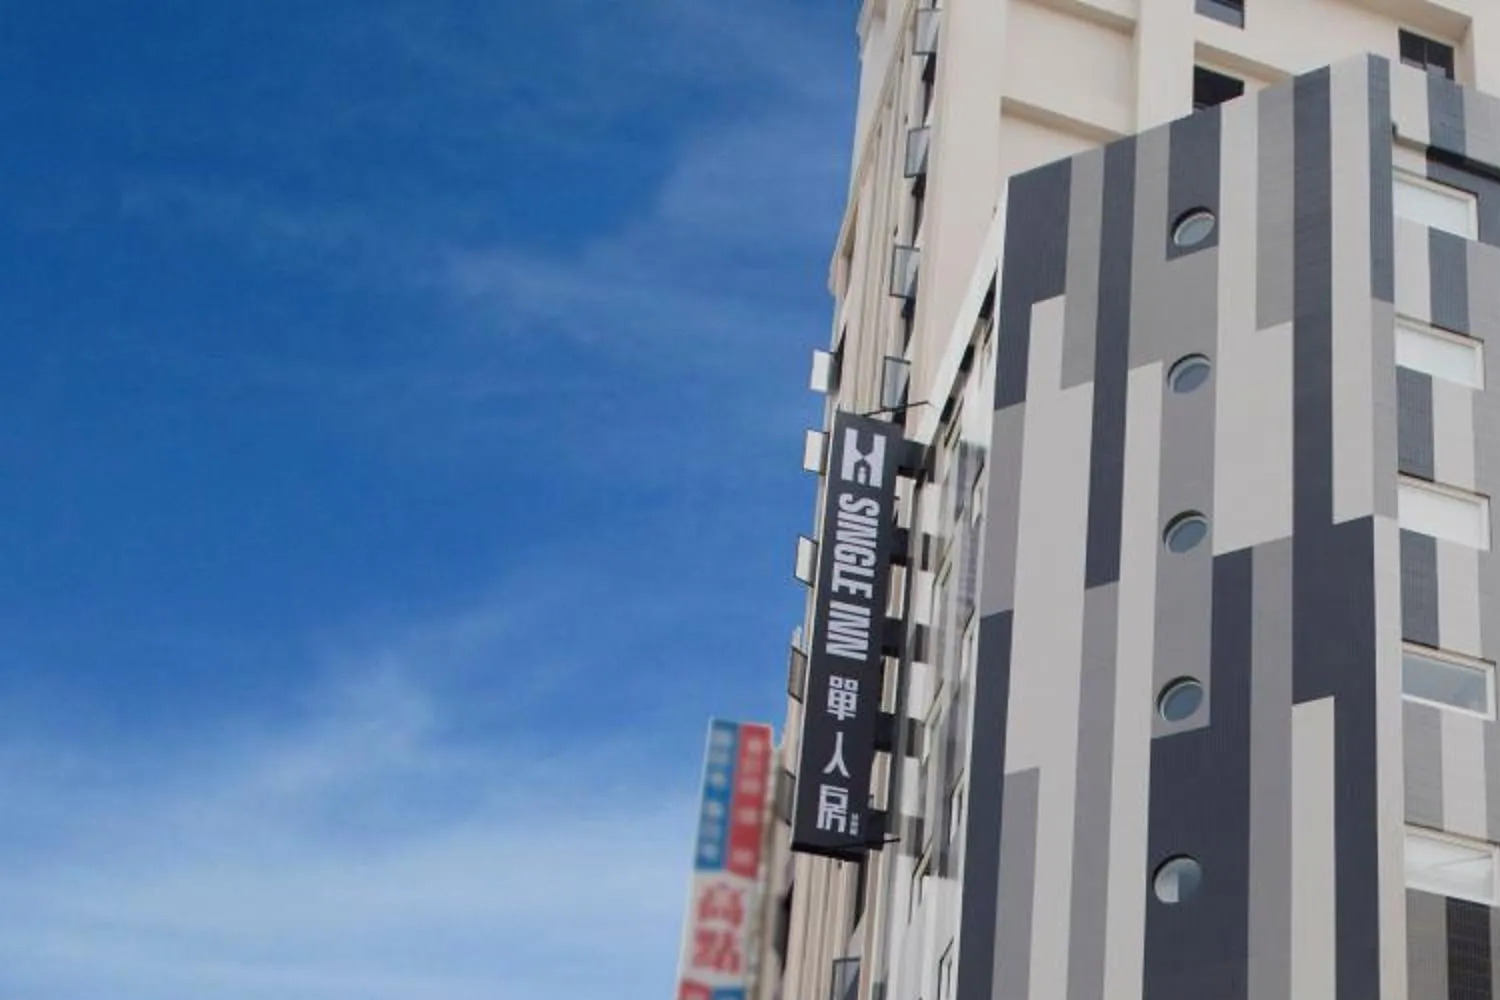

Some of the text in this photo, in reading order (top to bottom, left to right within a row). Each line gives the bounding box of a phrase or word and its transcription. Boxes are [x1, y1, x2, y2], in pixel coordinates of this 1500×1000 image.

[831, 493, 880, 600] SINGLE
[825, 601, 872, 661] INN
[815, 675, 860, 834] 單人房
